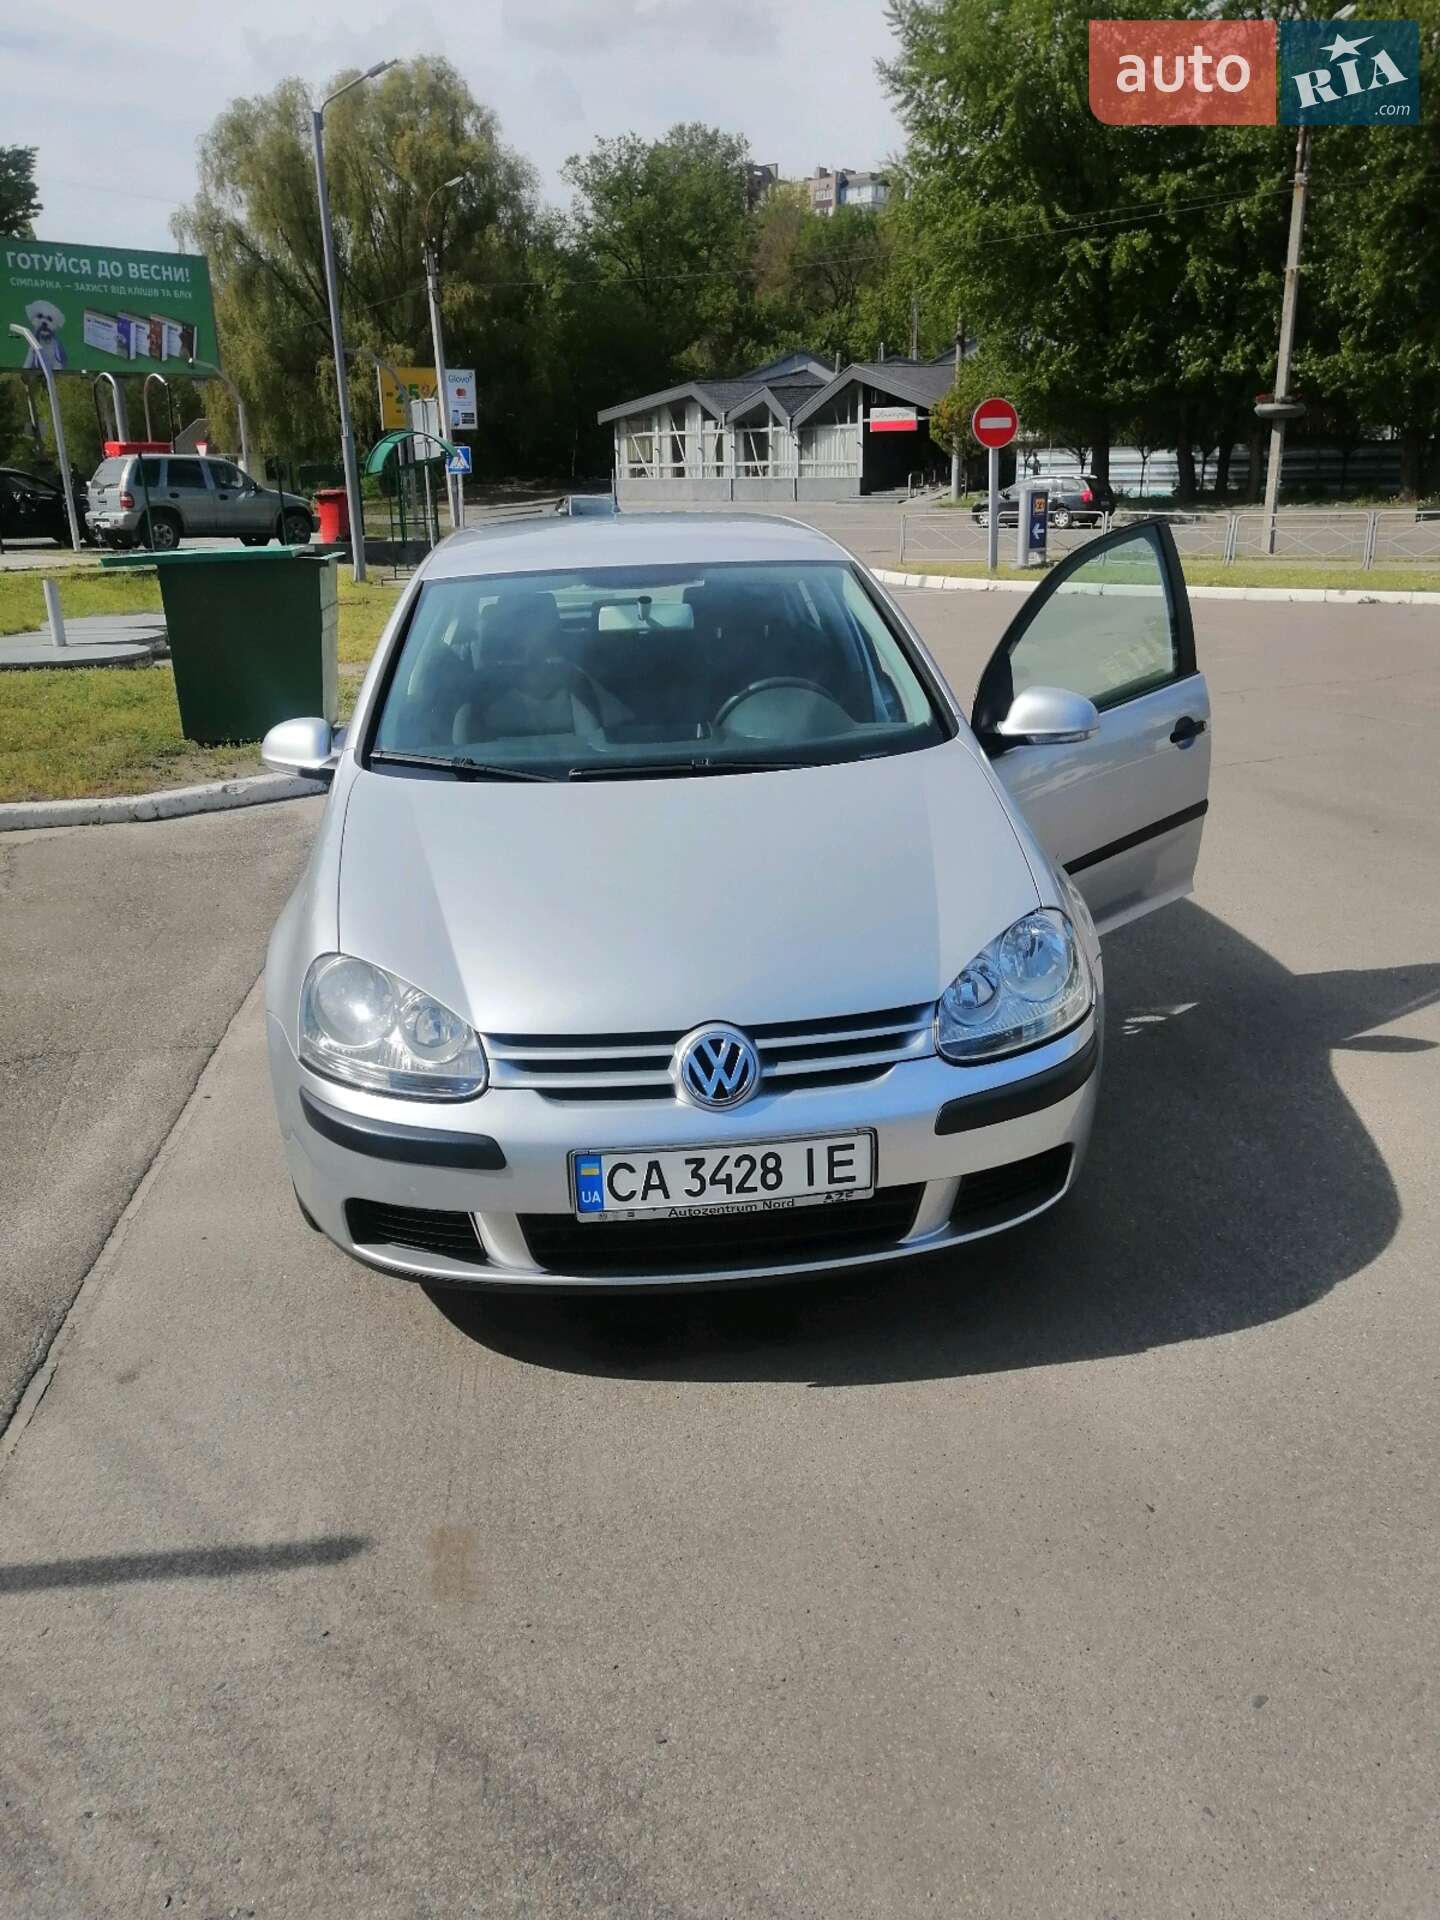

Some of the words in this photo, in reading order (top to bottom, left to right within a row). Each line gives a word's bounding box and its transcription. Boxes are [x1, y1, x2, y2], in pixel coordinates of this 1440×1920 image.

[6, 251, 92, 275] ГОТУЙСЯ
[97, 260, 123, 279] ДО
[127, 262, 191, 283] ВЕСНИ!
[160, 288, 172, 298] ТА
[581, 1190, 601, 1204] UA
[606, 1161, 671, 1202] CA
[683, 1151, 783, 1198] 3428
[806, 1143, 856, 1187] IE
[667, 1202, 758, 1218] Autozentrum
[762, 1198, 795, 1210] Nord
